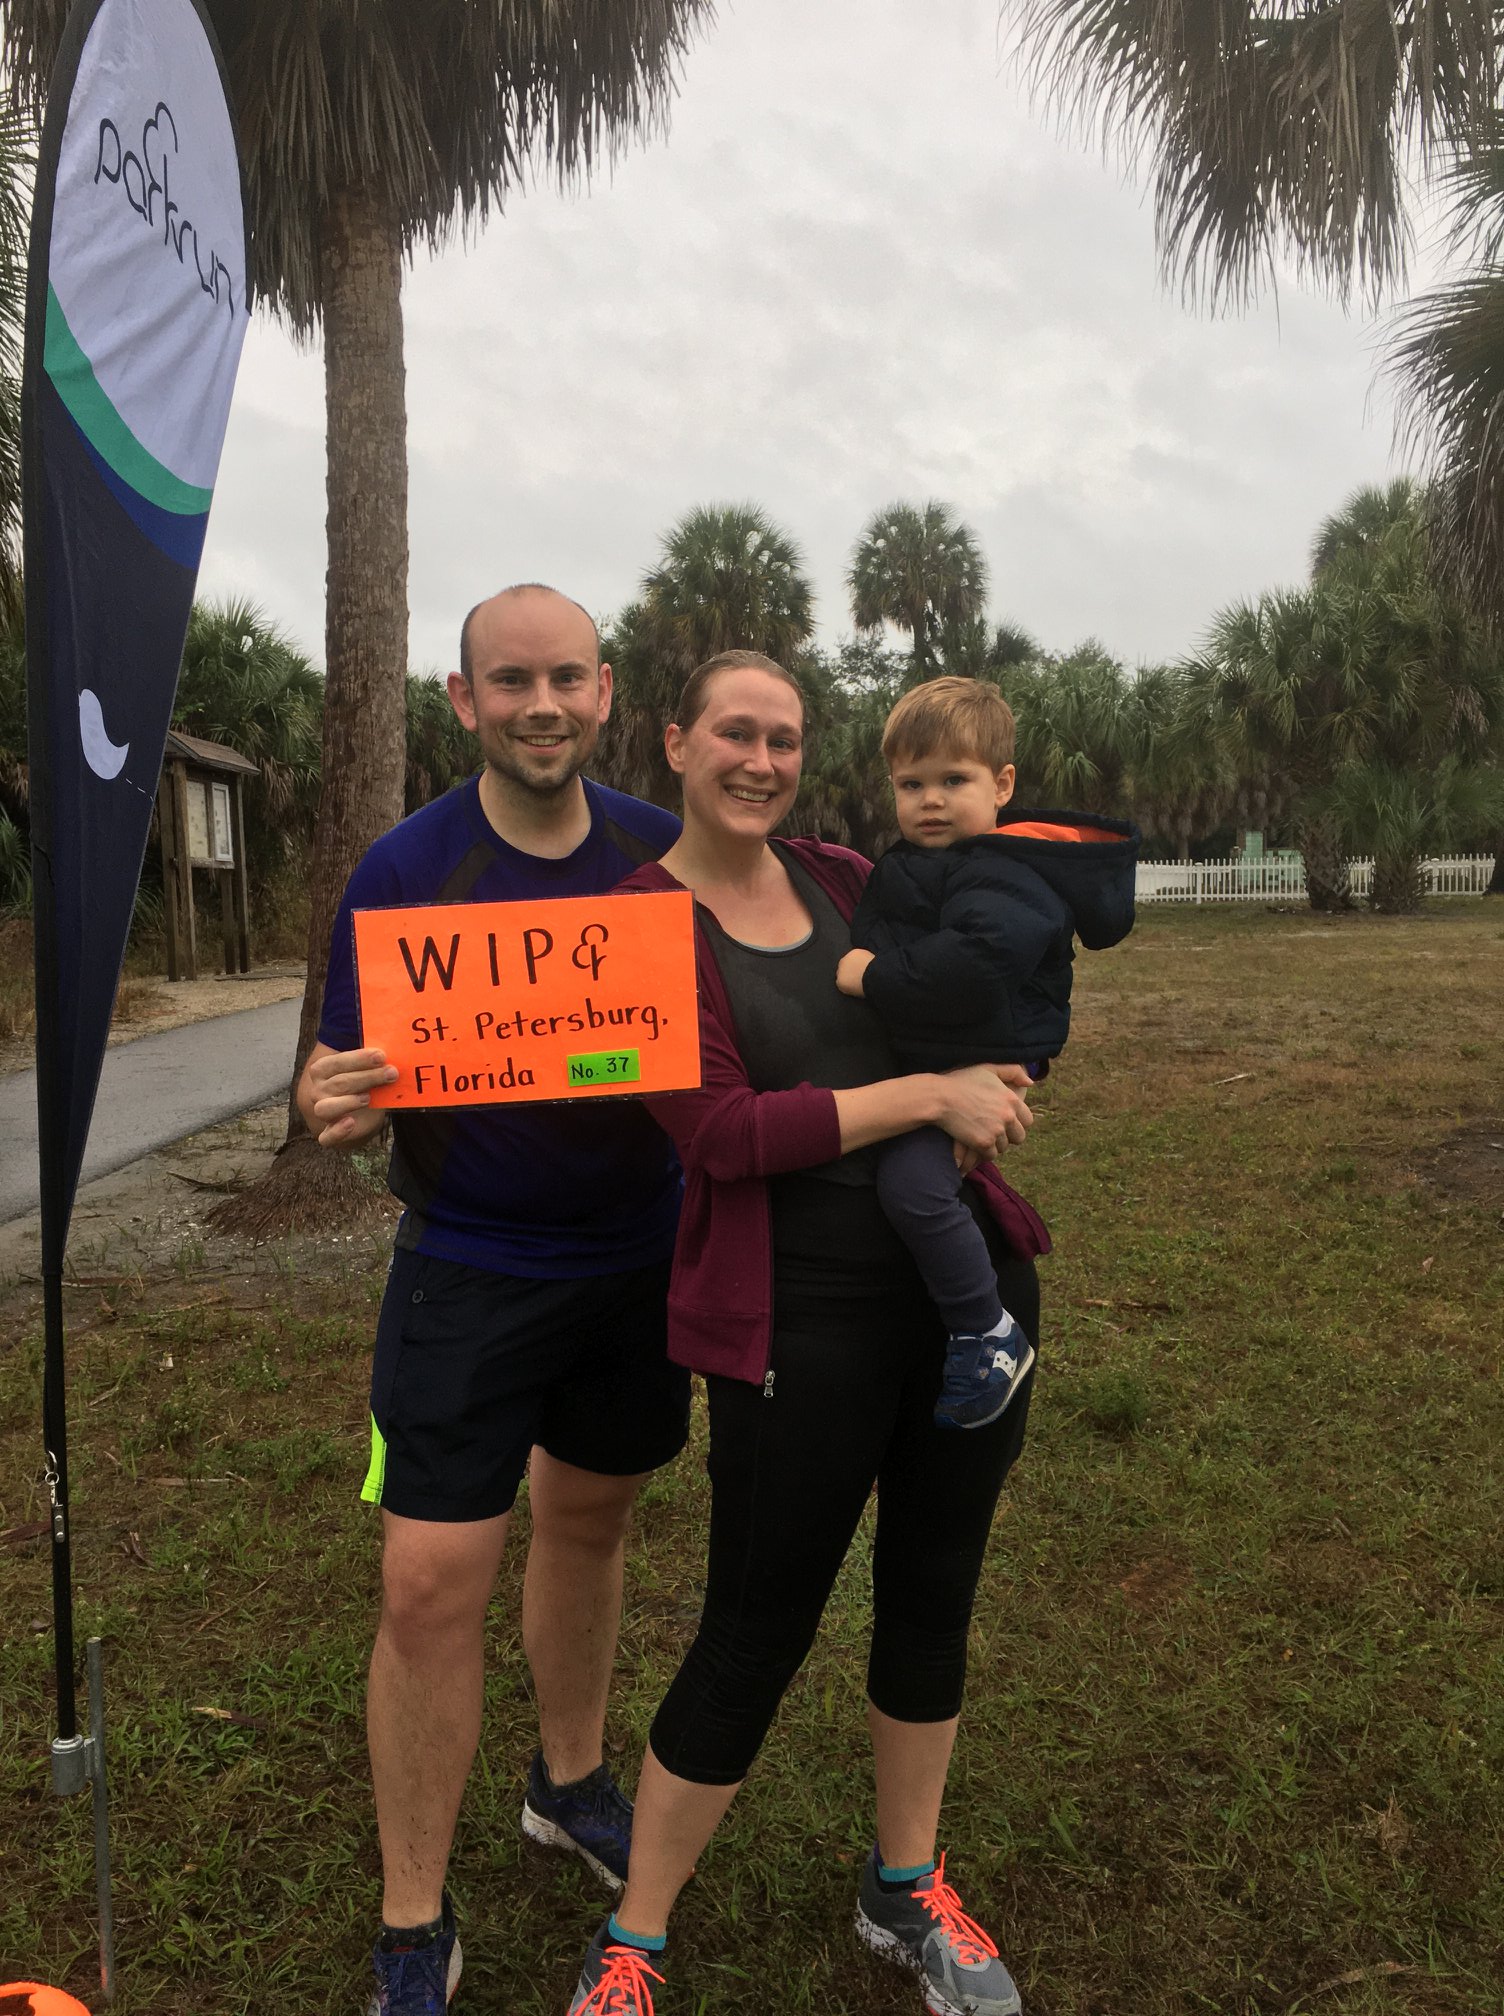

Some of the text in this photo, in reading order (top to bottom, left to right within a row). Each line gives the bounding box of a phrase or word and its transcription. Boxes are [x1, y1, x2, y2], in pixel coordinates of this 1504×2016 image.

[94, 118, 235, 321] parkrun
[571, 923, 609, 982] &
[411, 998, 669, 1044] St. Petersburg,
[414, 1057, 536, 1094] Florida
[571, 1056, 630, 1080] No. 37
